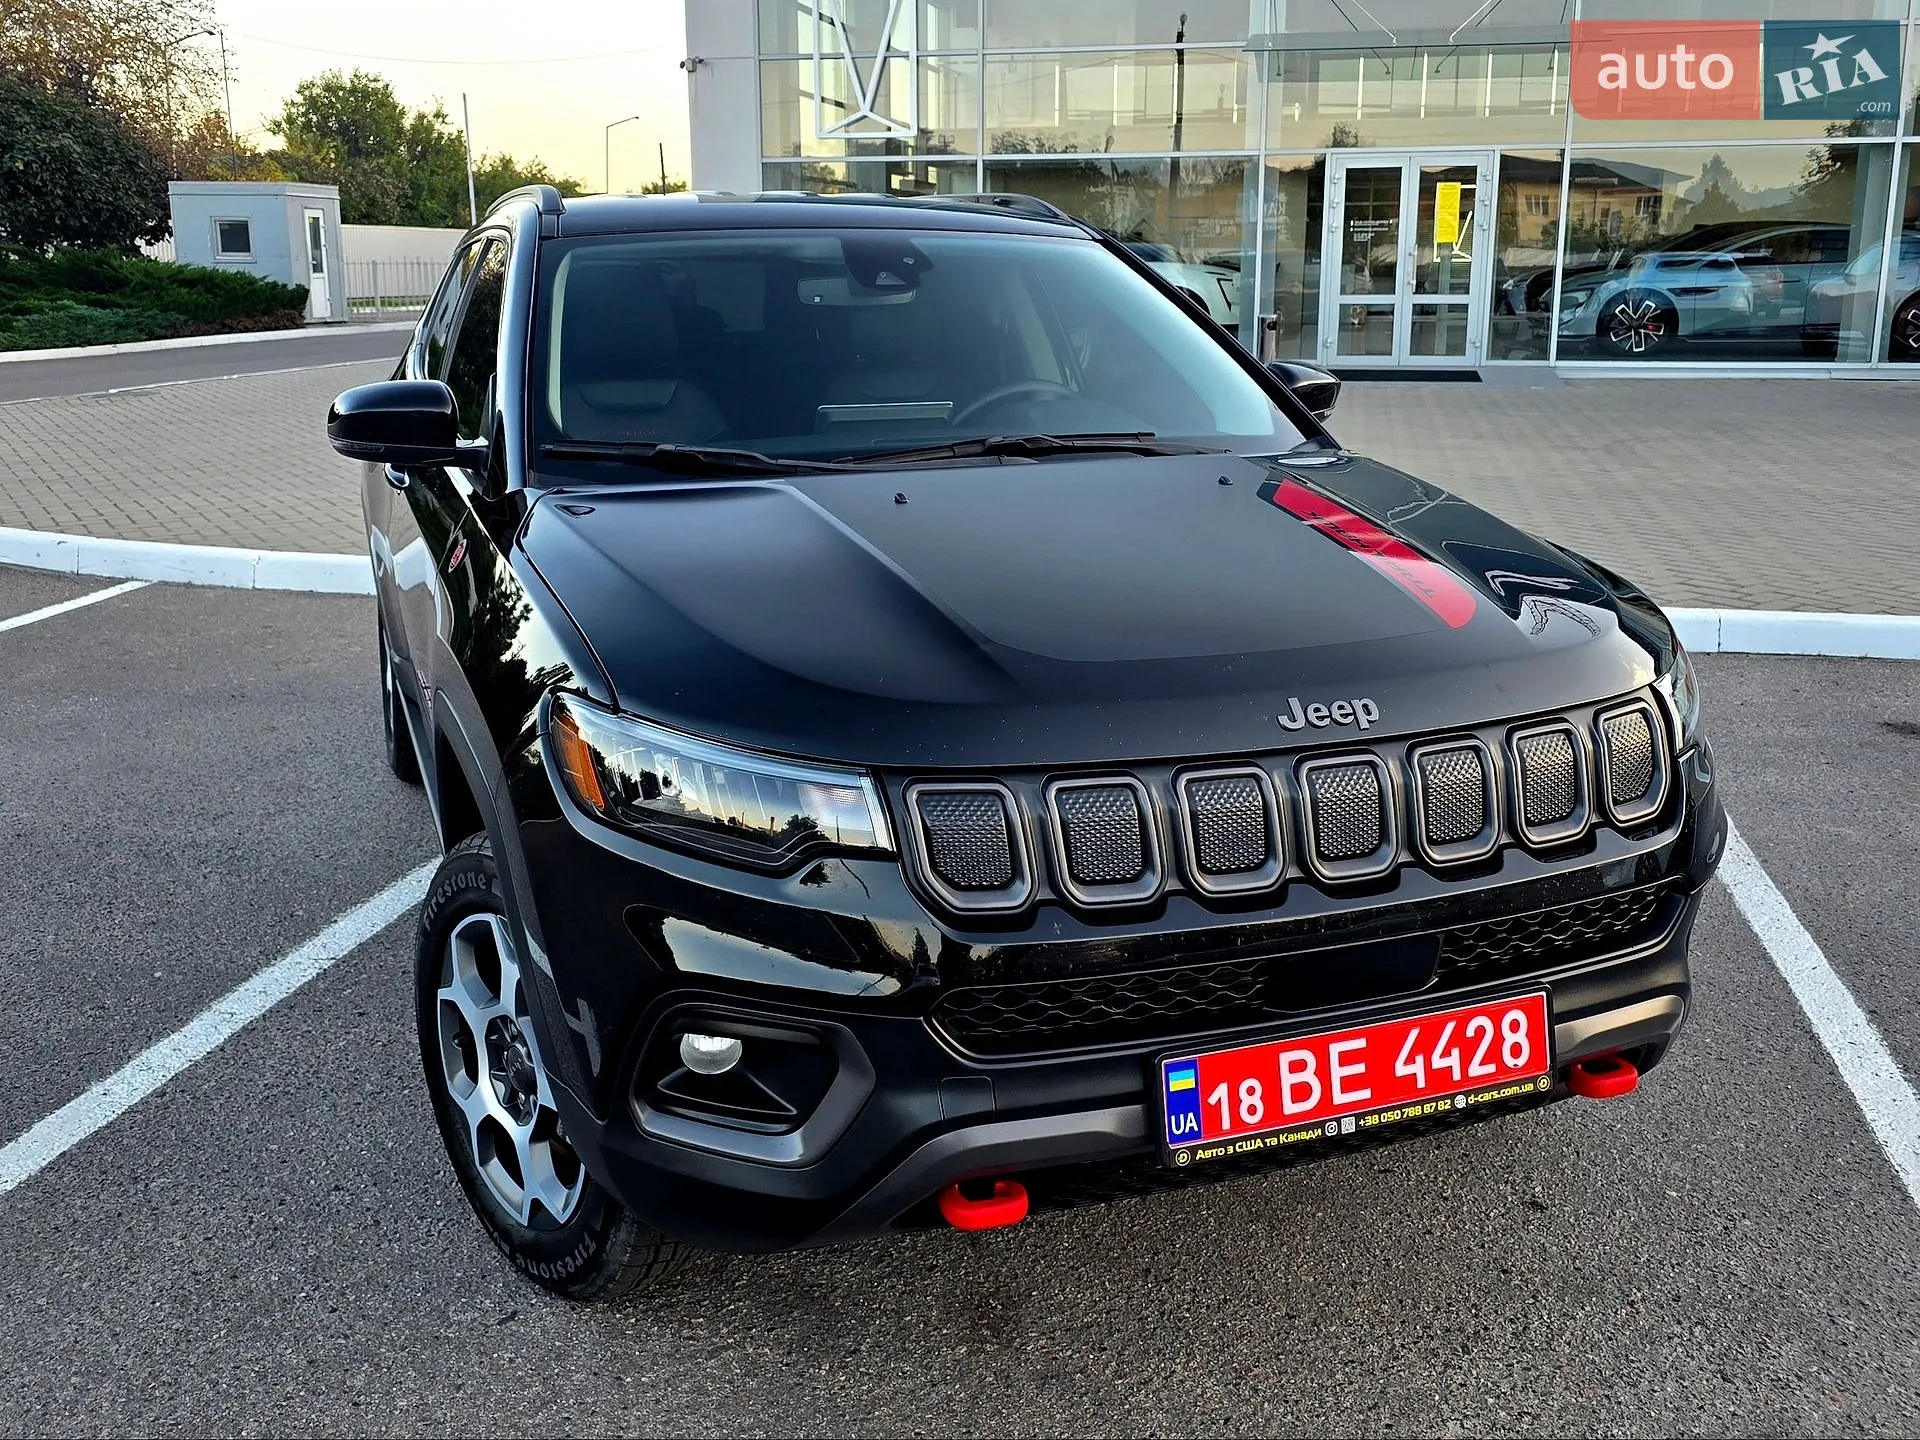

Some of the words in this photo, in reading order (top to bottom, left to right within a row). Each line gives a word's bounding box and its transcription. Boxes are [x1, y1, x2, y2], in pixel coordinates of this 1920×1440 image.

[1277, 697, 1380, 732] Jeep
[424, 871, 487, 932] Firestone
[1207, 1078, 1265, 1131] 18
[1279, 1038, 1370, 1115] BE
[1394, 1009, 1531, 1089] 4428
[1467, 1082, 1534, 1104] d-cars.com.ua
[1170, 1112, 1198, 1135] UA
[1359, 1114, 1379, 1127] +38
[1380, 1109, 1402, 1123] 050
[1402, 1105, 1422, 1118] 788
[1423, 1102, 1437, 1114] 87
[1437, 1099, 1452, 1111] 82
[1195, 1147, 1226, 1160] Авто
[1226, 1145, 1234, 1154] з
[1235, 1138, 1264, 1152] США
[1265, 1137, 1278, 1146] та
[1279, 1128, 1322, 1144] Канади
